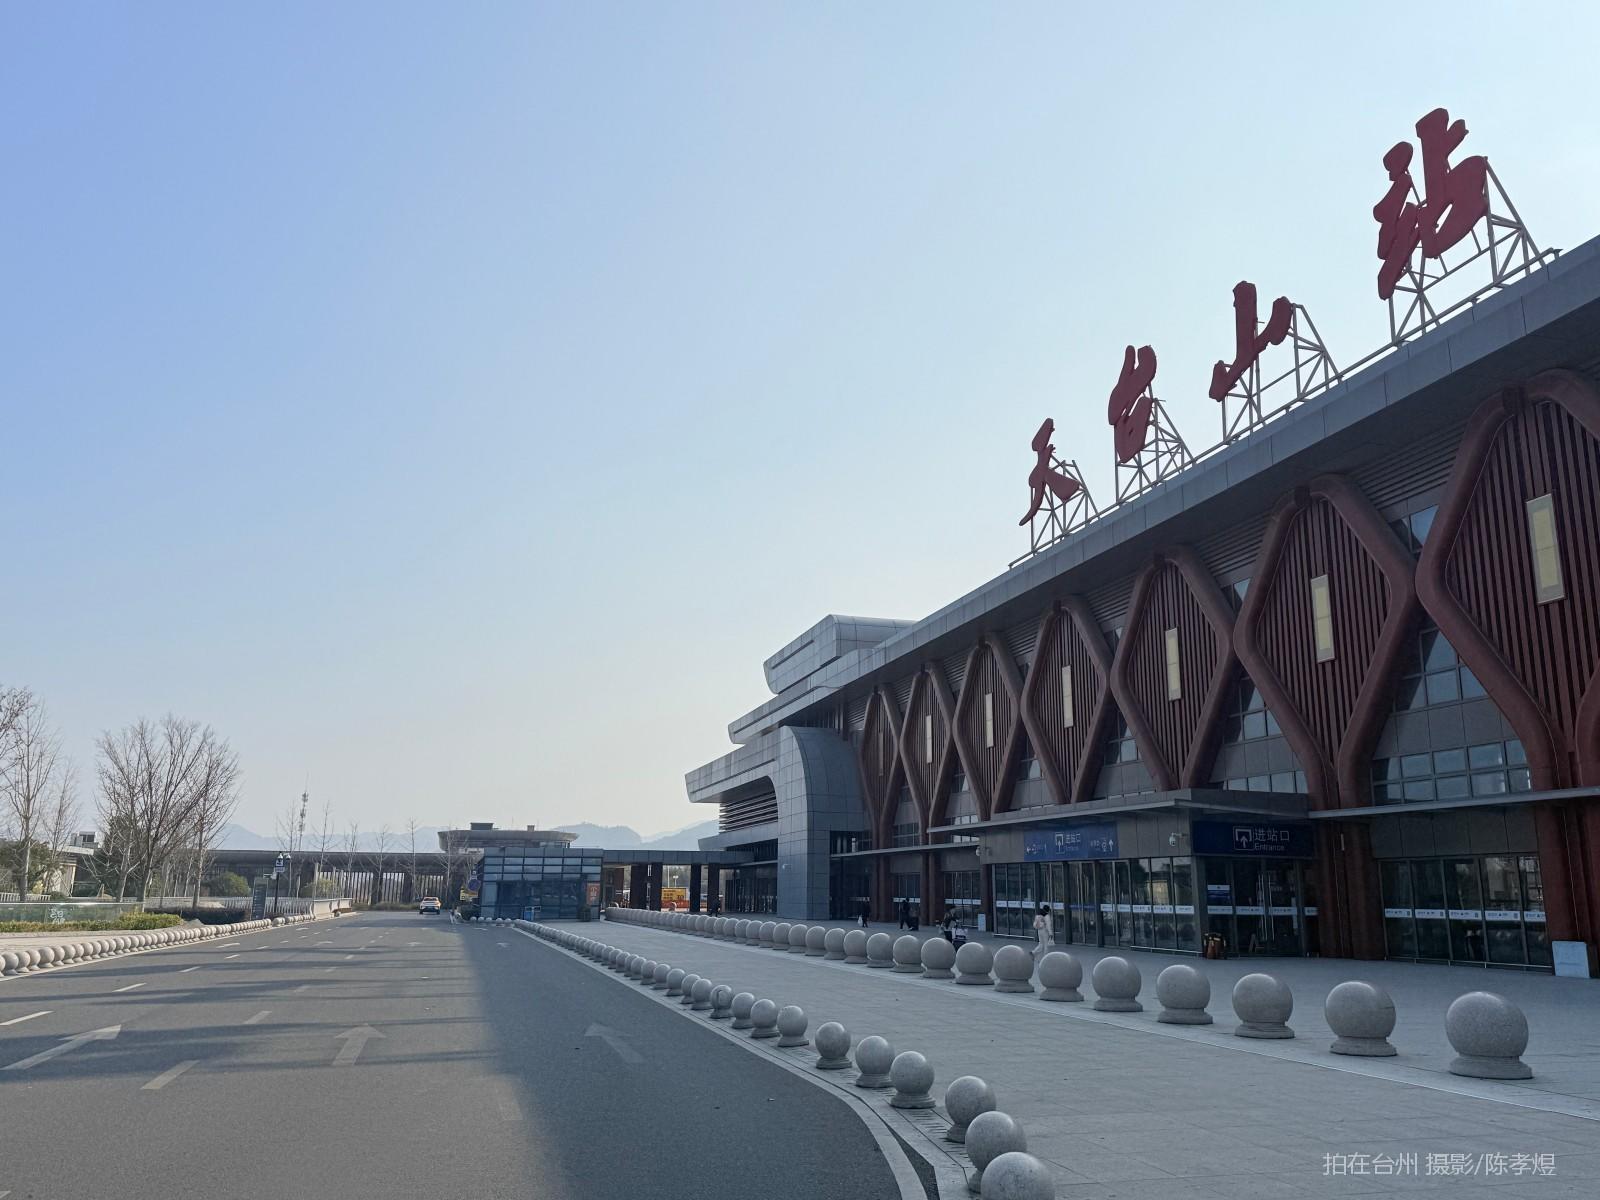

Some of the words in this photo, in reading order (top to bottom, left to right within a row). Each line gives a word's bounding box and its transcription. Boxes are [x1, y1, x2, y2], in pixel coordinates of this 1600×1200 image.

[1019, 107, 1487, 526] 天台山站
[1254, 827, 1290, 843] 进站口
[1254, 843, 1285, 851] Entrance
